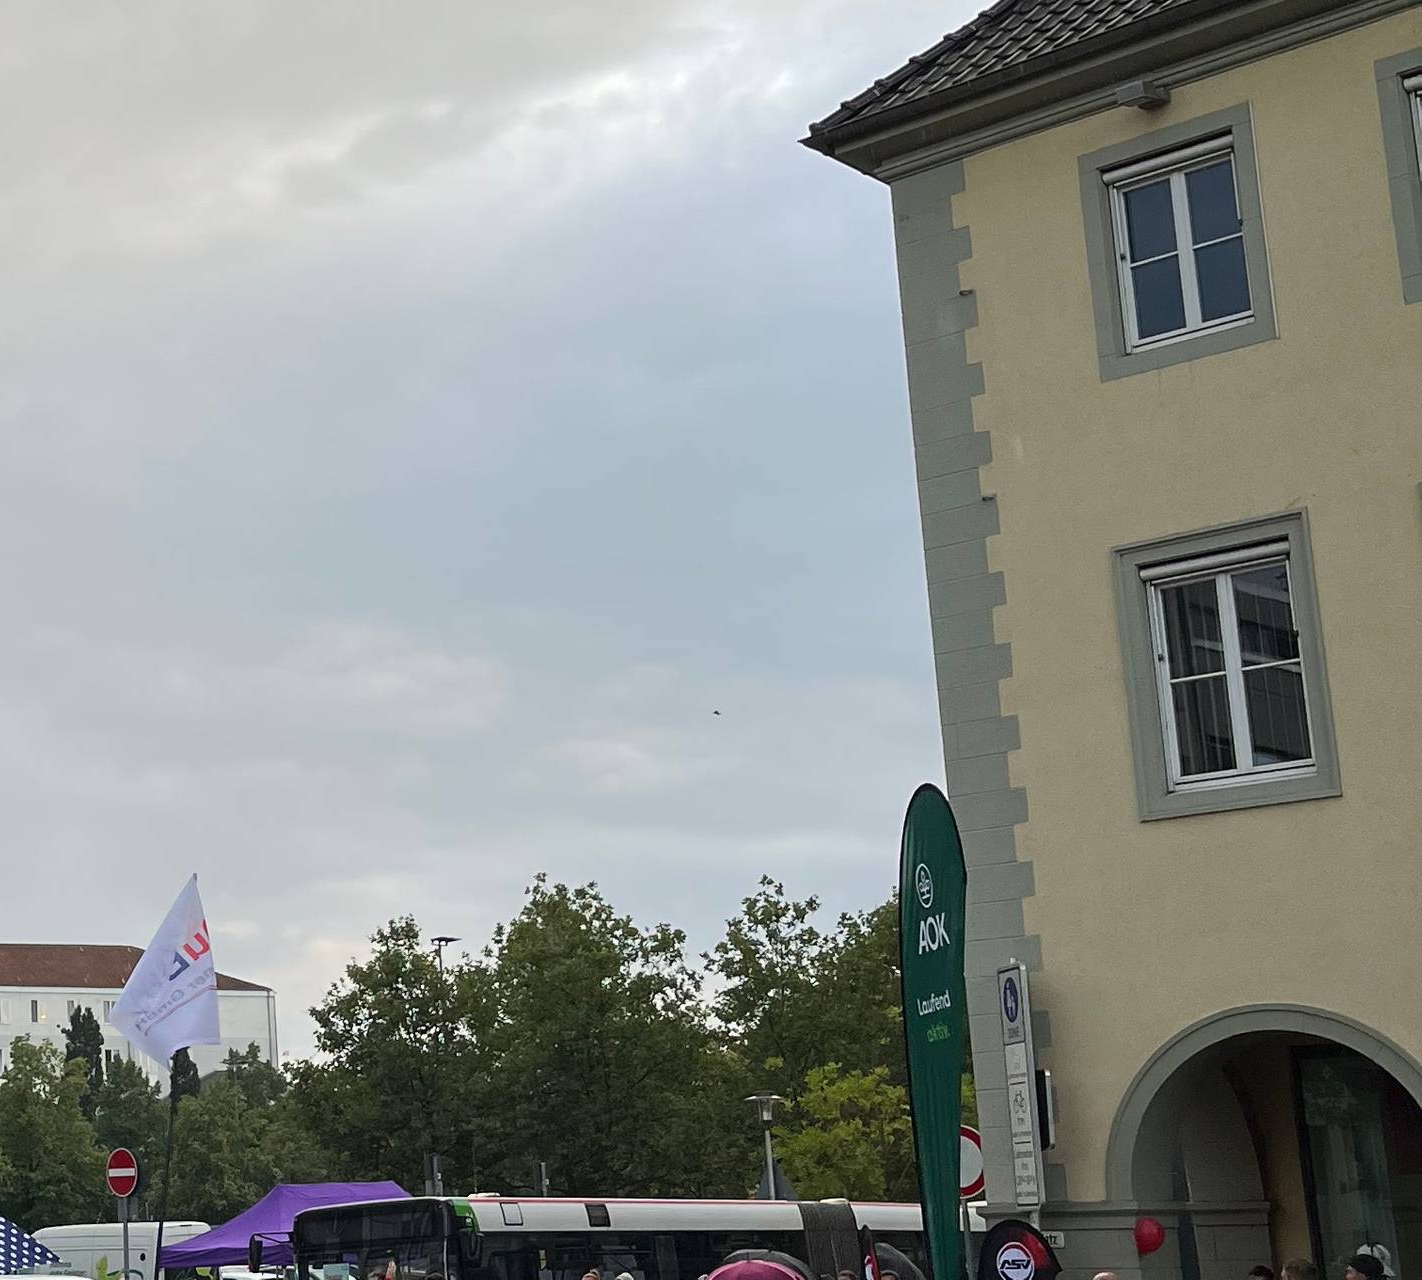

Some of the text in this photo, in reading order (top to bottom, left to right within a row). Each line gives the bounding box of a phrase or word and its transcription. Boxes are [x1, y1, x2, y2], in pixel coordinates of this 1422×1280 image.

[918, 912, 951, 955] AOK
[917, 989, 952, 1016] Laufend
[999, 1259, 1032, 1270] ASV
